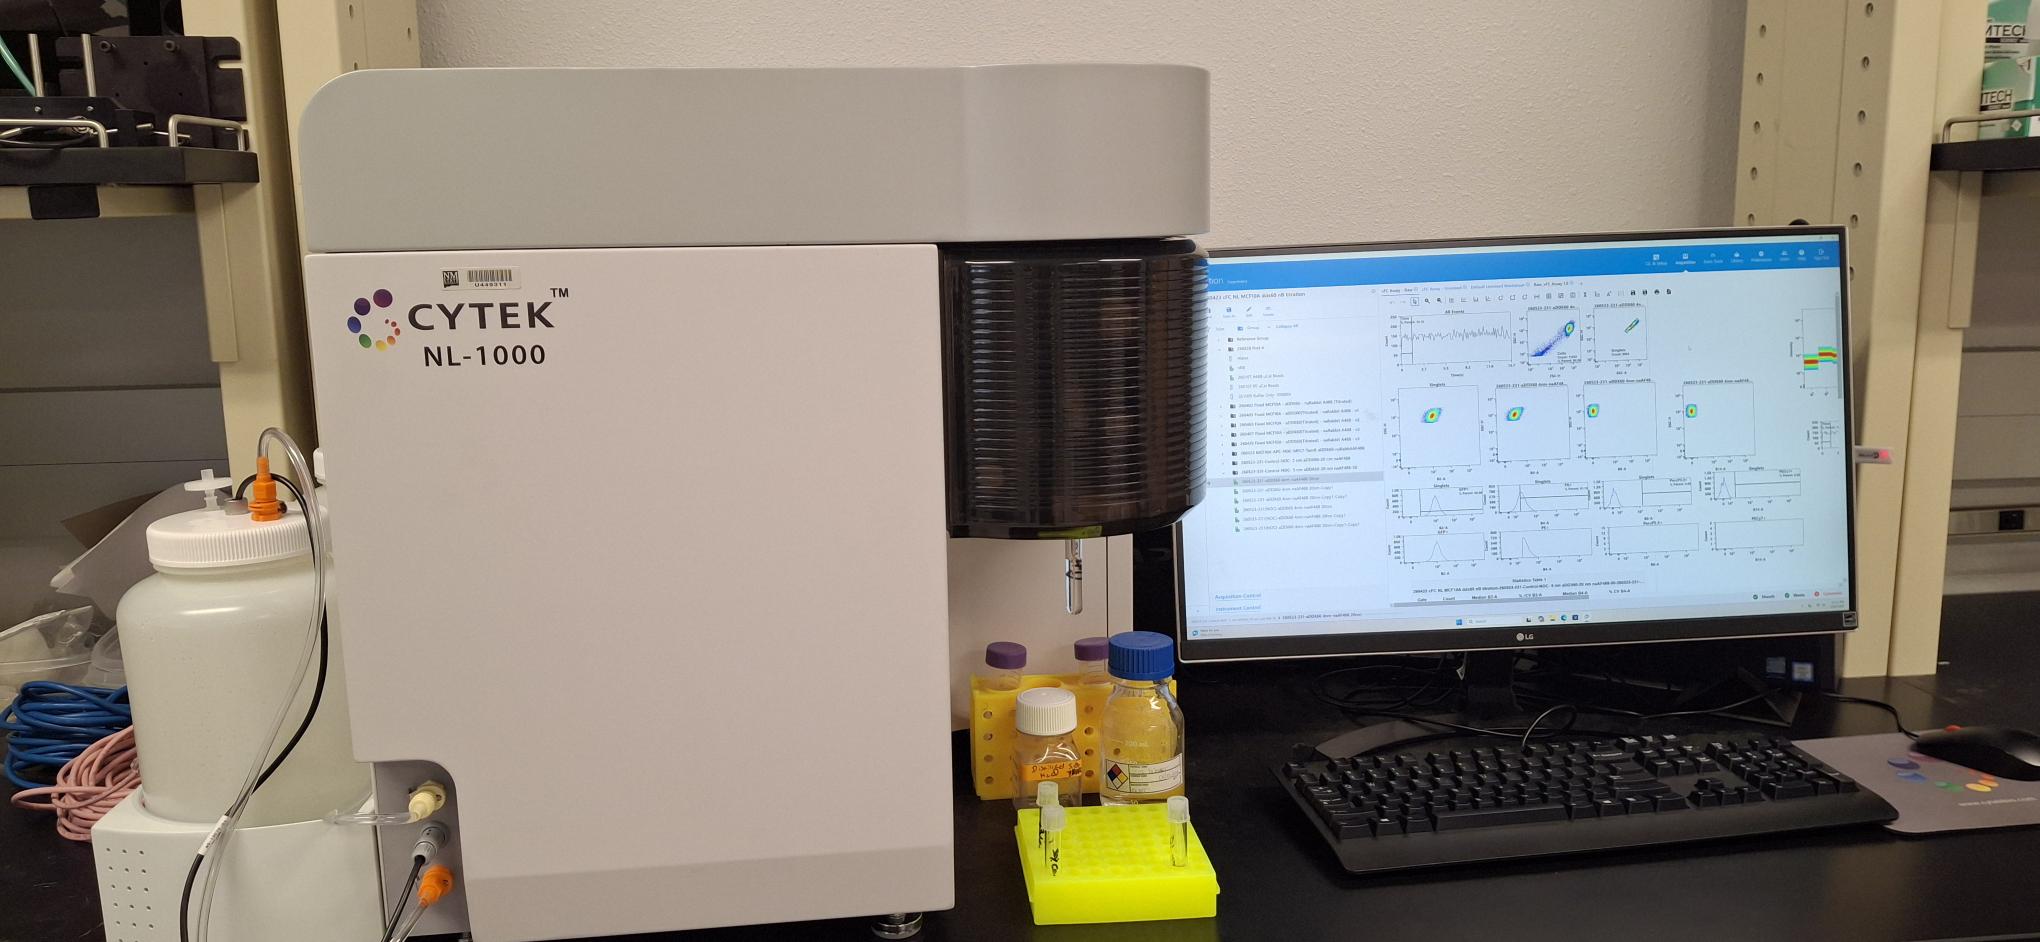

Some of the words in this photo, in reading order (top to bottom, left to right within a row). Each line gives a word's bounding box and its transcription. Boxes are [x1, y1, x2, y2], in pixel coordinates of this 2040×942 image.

[1981, 90, 2012, 104] TECH
[550, 287, 569, 298] TM
[407, 301, 555, 331] CYTEK
[423, 345, 546, 367] NL-1000
